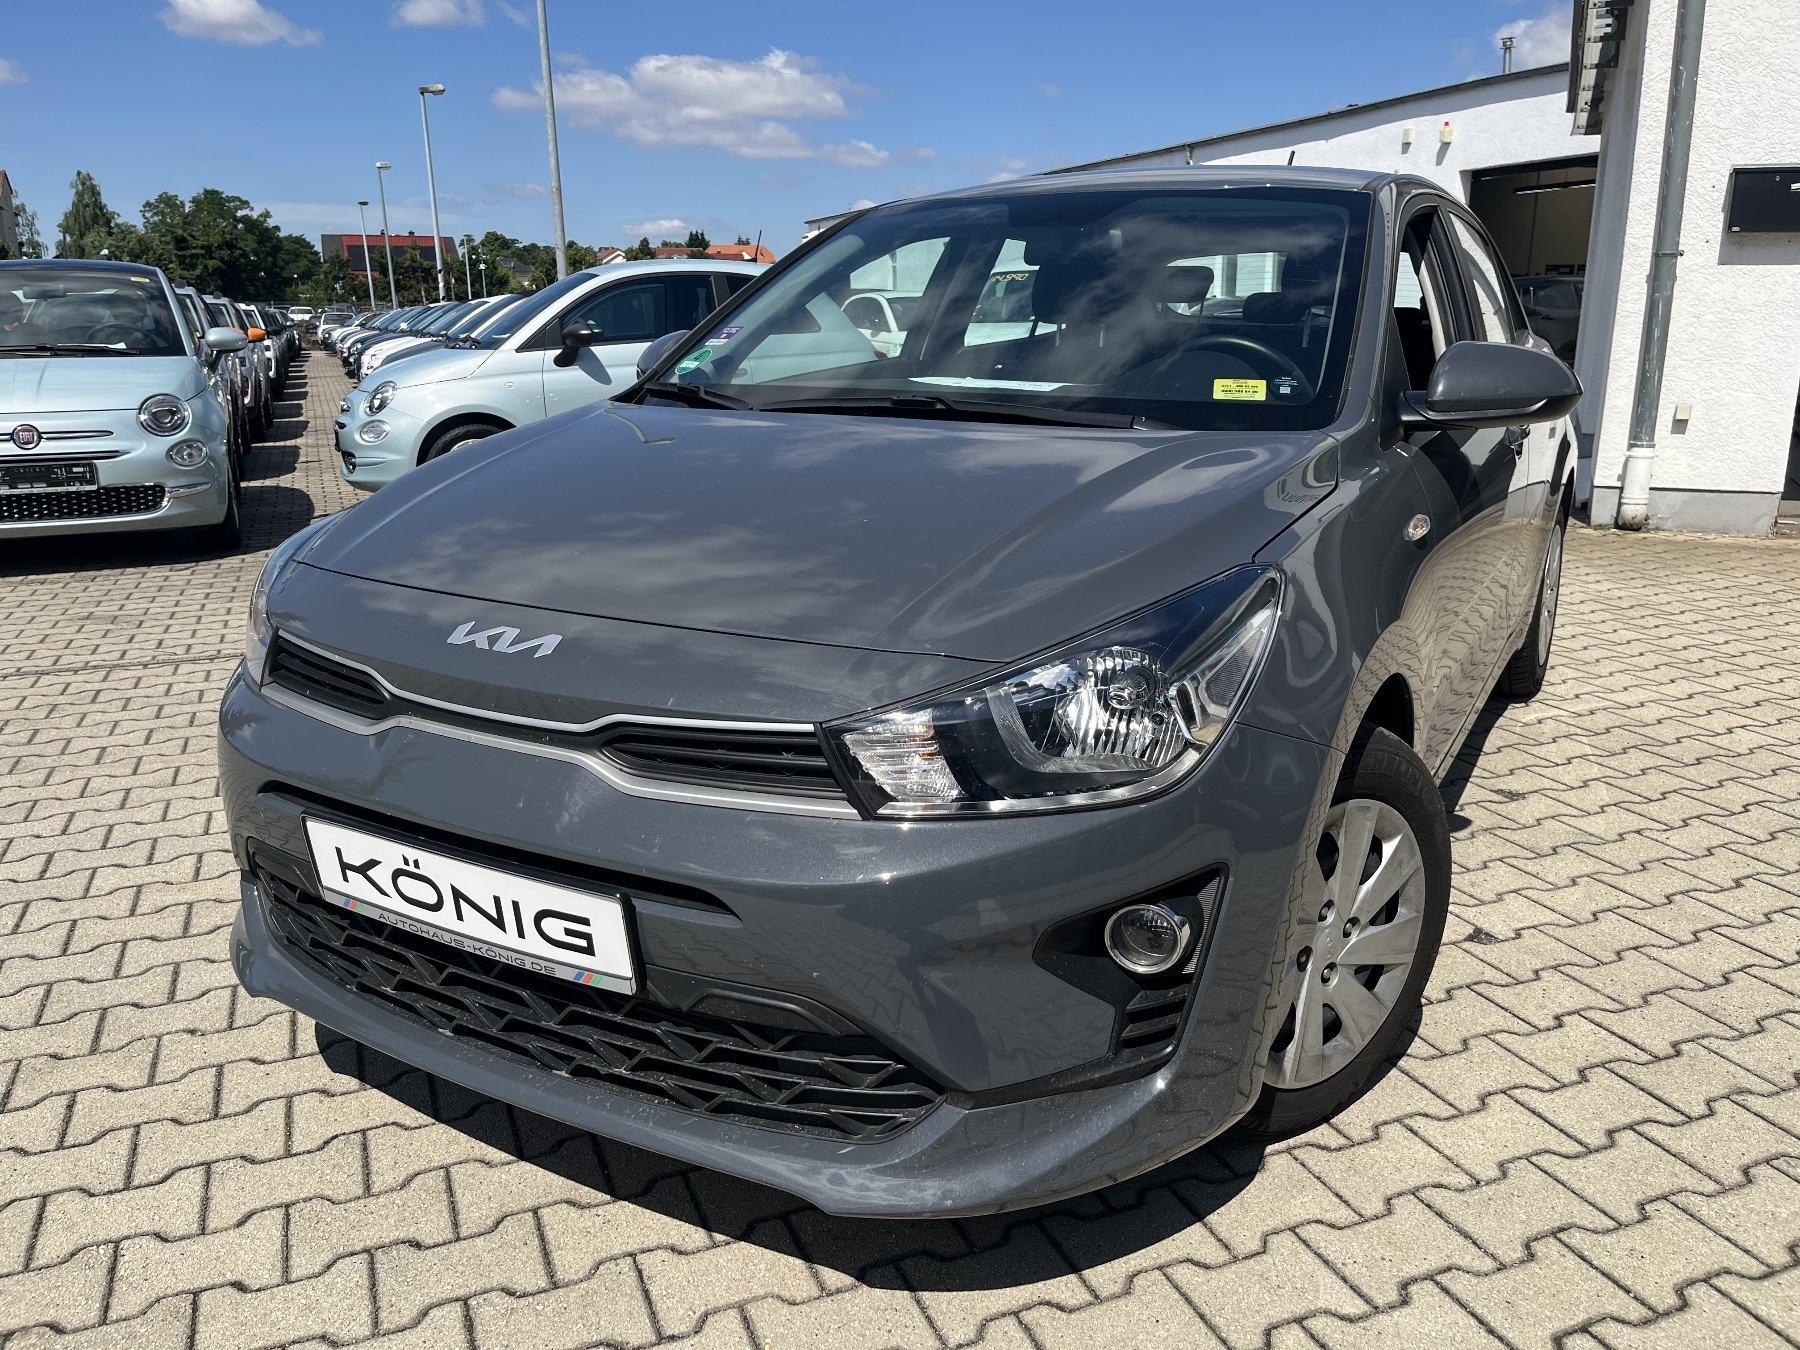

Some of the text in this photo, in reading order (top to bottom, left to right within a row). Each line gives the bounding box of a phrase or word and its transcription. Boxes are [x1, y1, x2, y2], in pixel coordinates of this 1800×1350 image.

[18, 432, 35, 443] FIAT
[446, 620, 564, 659] KIA
[334, 846, 596, 957] KÖNIG
[378, 912, 557, 977] AUTOHAUS-KÖNIG.DE
